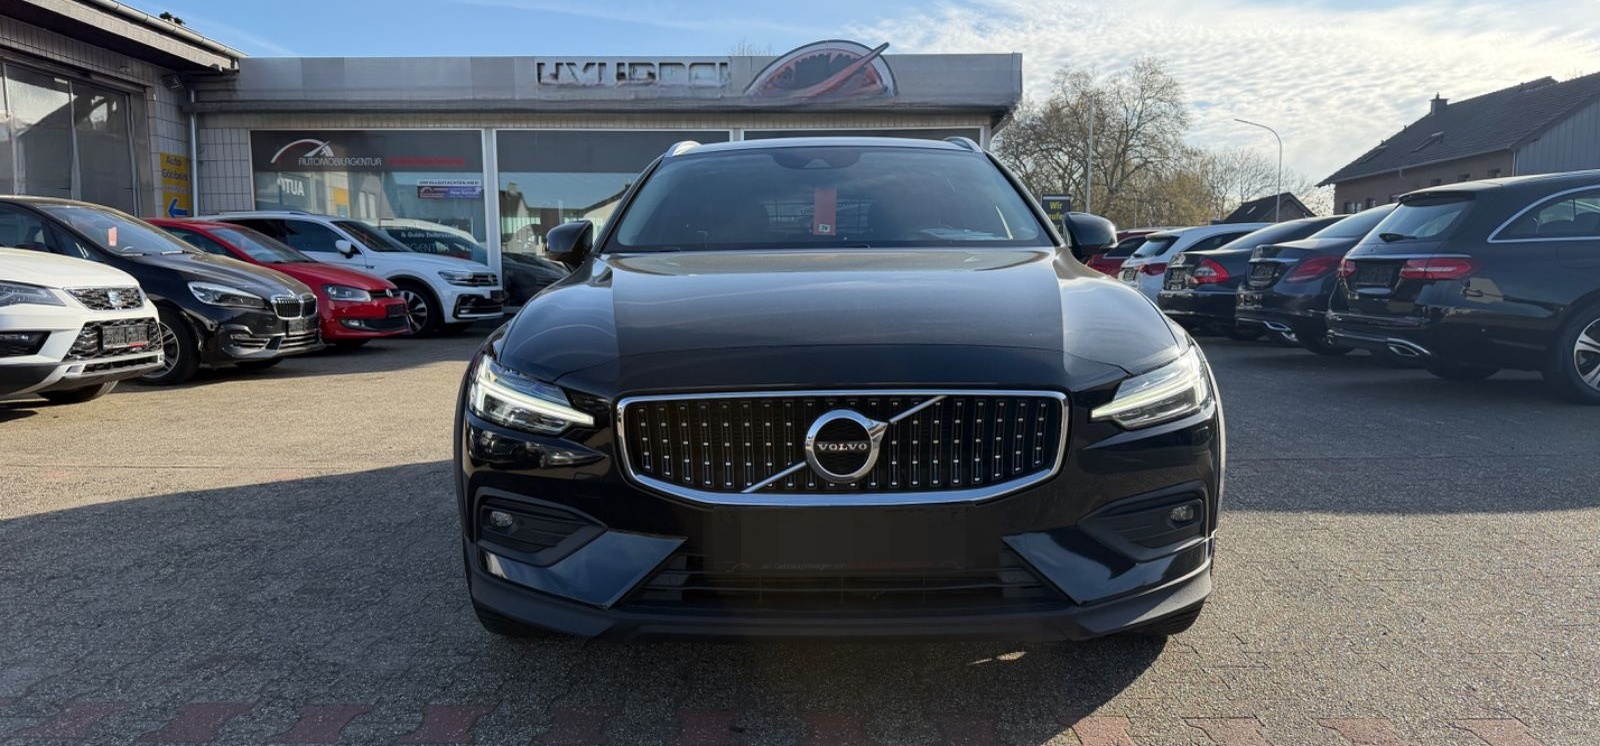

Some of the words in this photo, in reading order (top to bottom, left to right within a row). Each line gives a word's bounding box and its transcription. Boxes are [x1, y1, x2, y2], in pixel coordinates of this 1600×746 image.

[298, 157, 382, 167] AUTOMOBILAGENTUR
[1050, 201, 1063, 210] Wir
[817, 443, 868, 451] VOLVO
